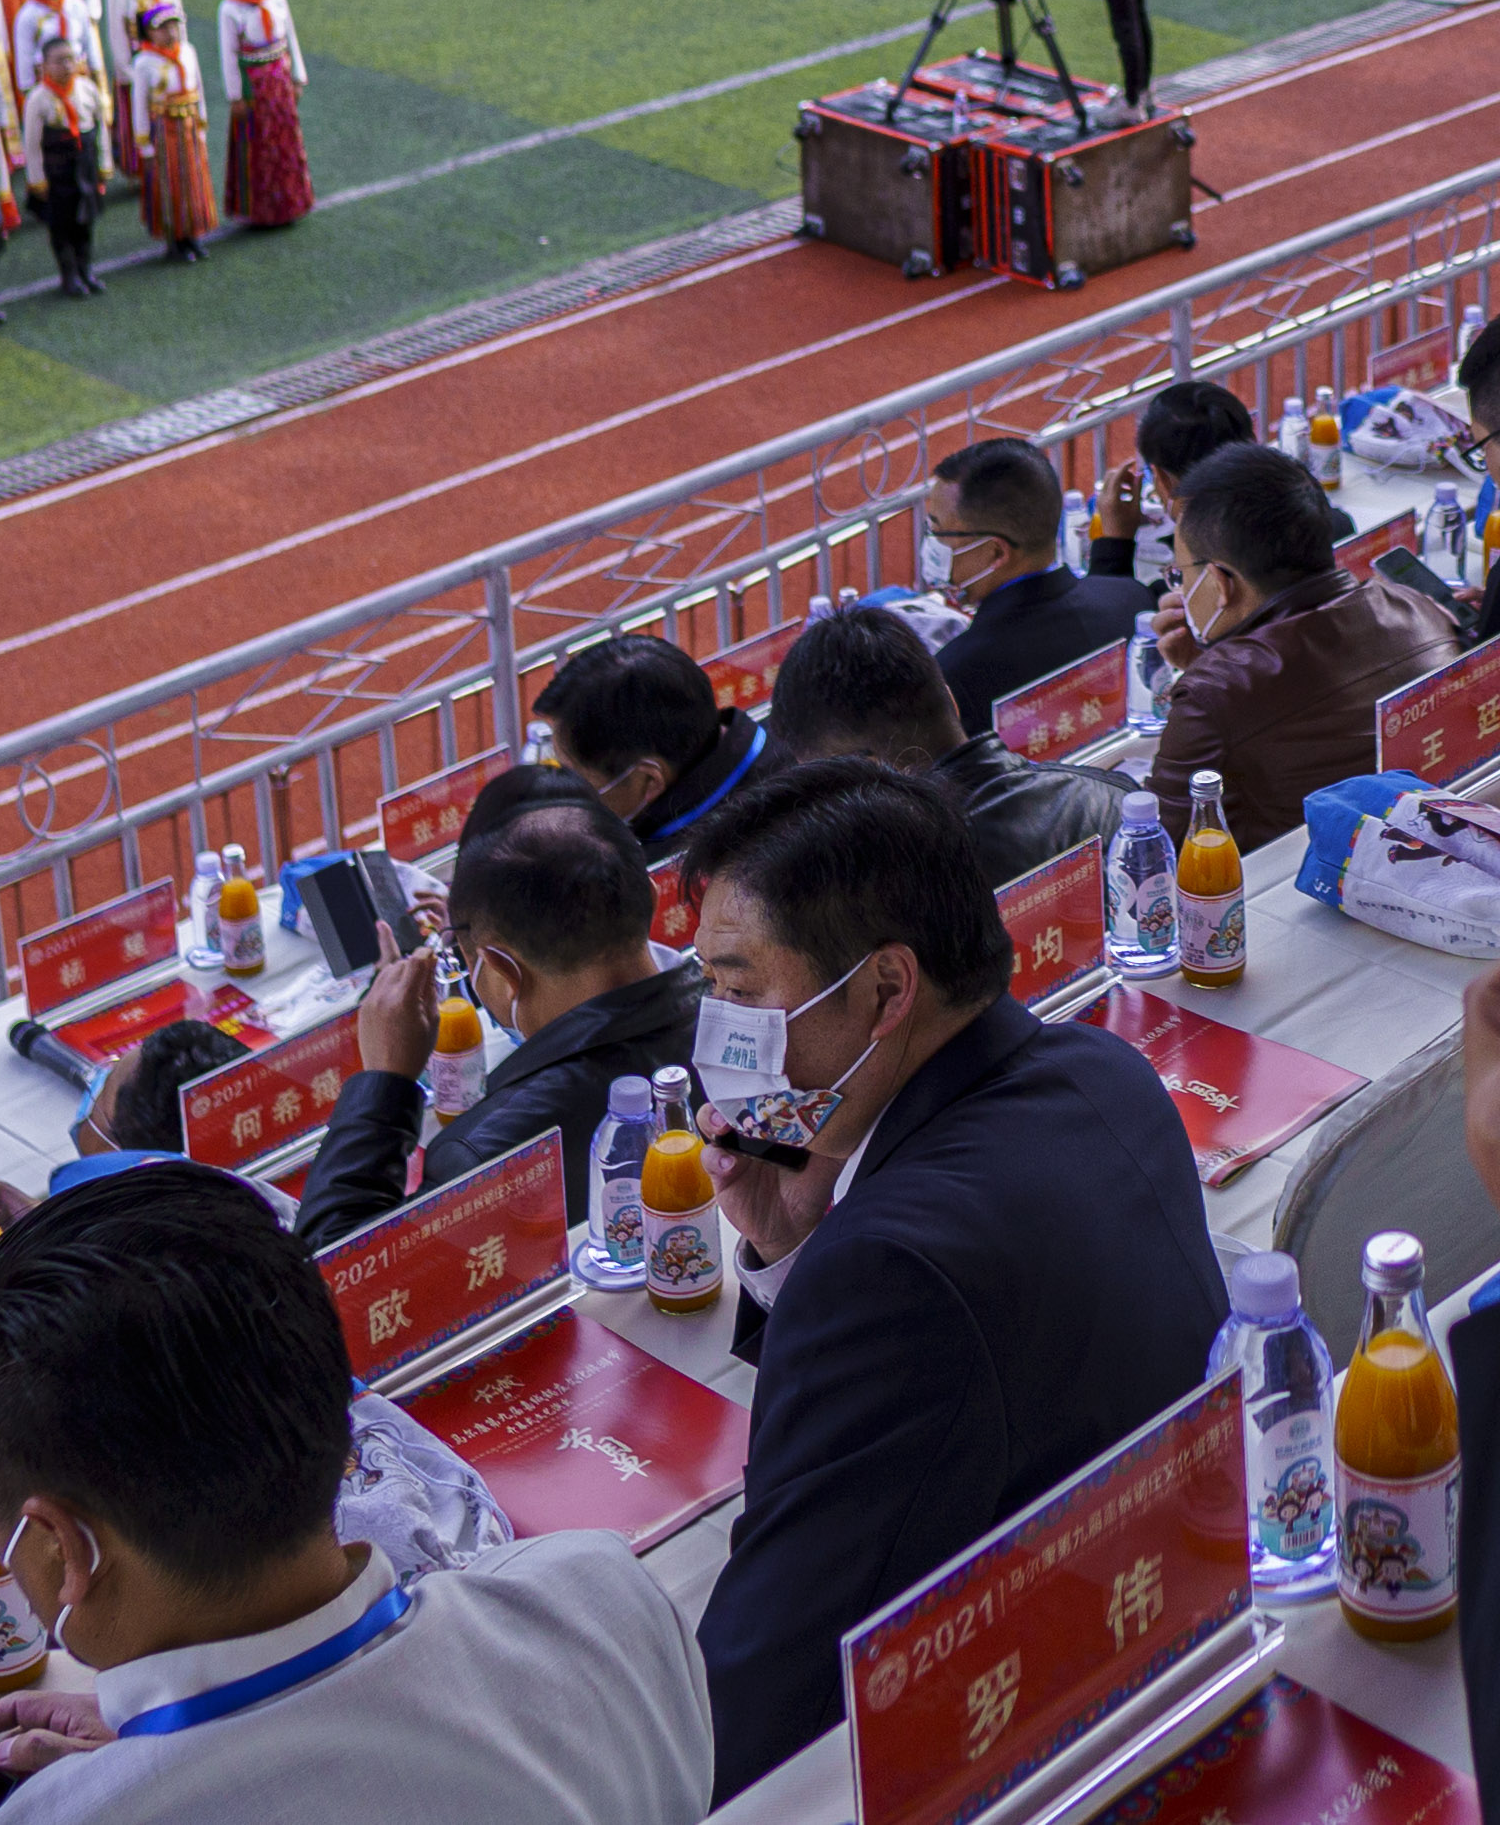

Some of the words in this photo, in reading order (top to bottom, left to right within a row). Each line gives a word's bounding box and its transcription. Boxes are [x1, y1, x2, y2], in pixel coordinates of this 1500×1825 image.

[1401, 694, 1436, 728] 2021
[211, 1075, 253, 1109] 2021
[333, 1246, 390, 1295] 2021
[368, 1233, 508, 1346] 欧涛
[910, 1586, 995, 1680] 2021
[966, 1552, 1165, 1762] 罗伟
